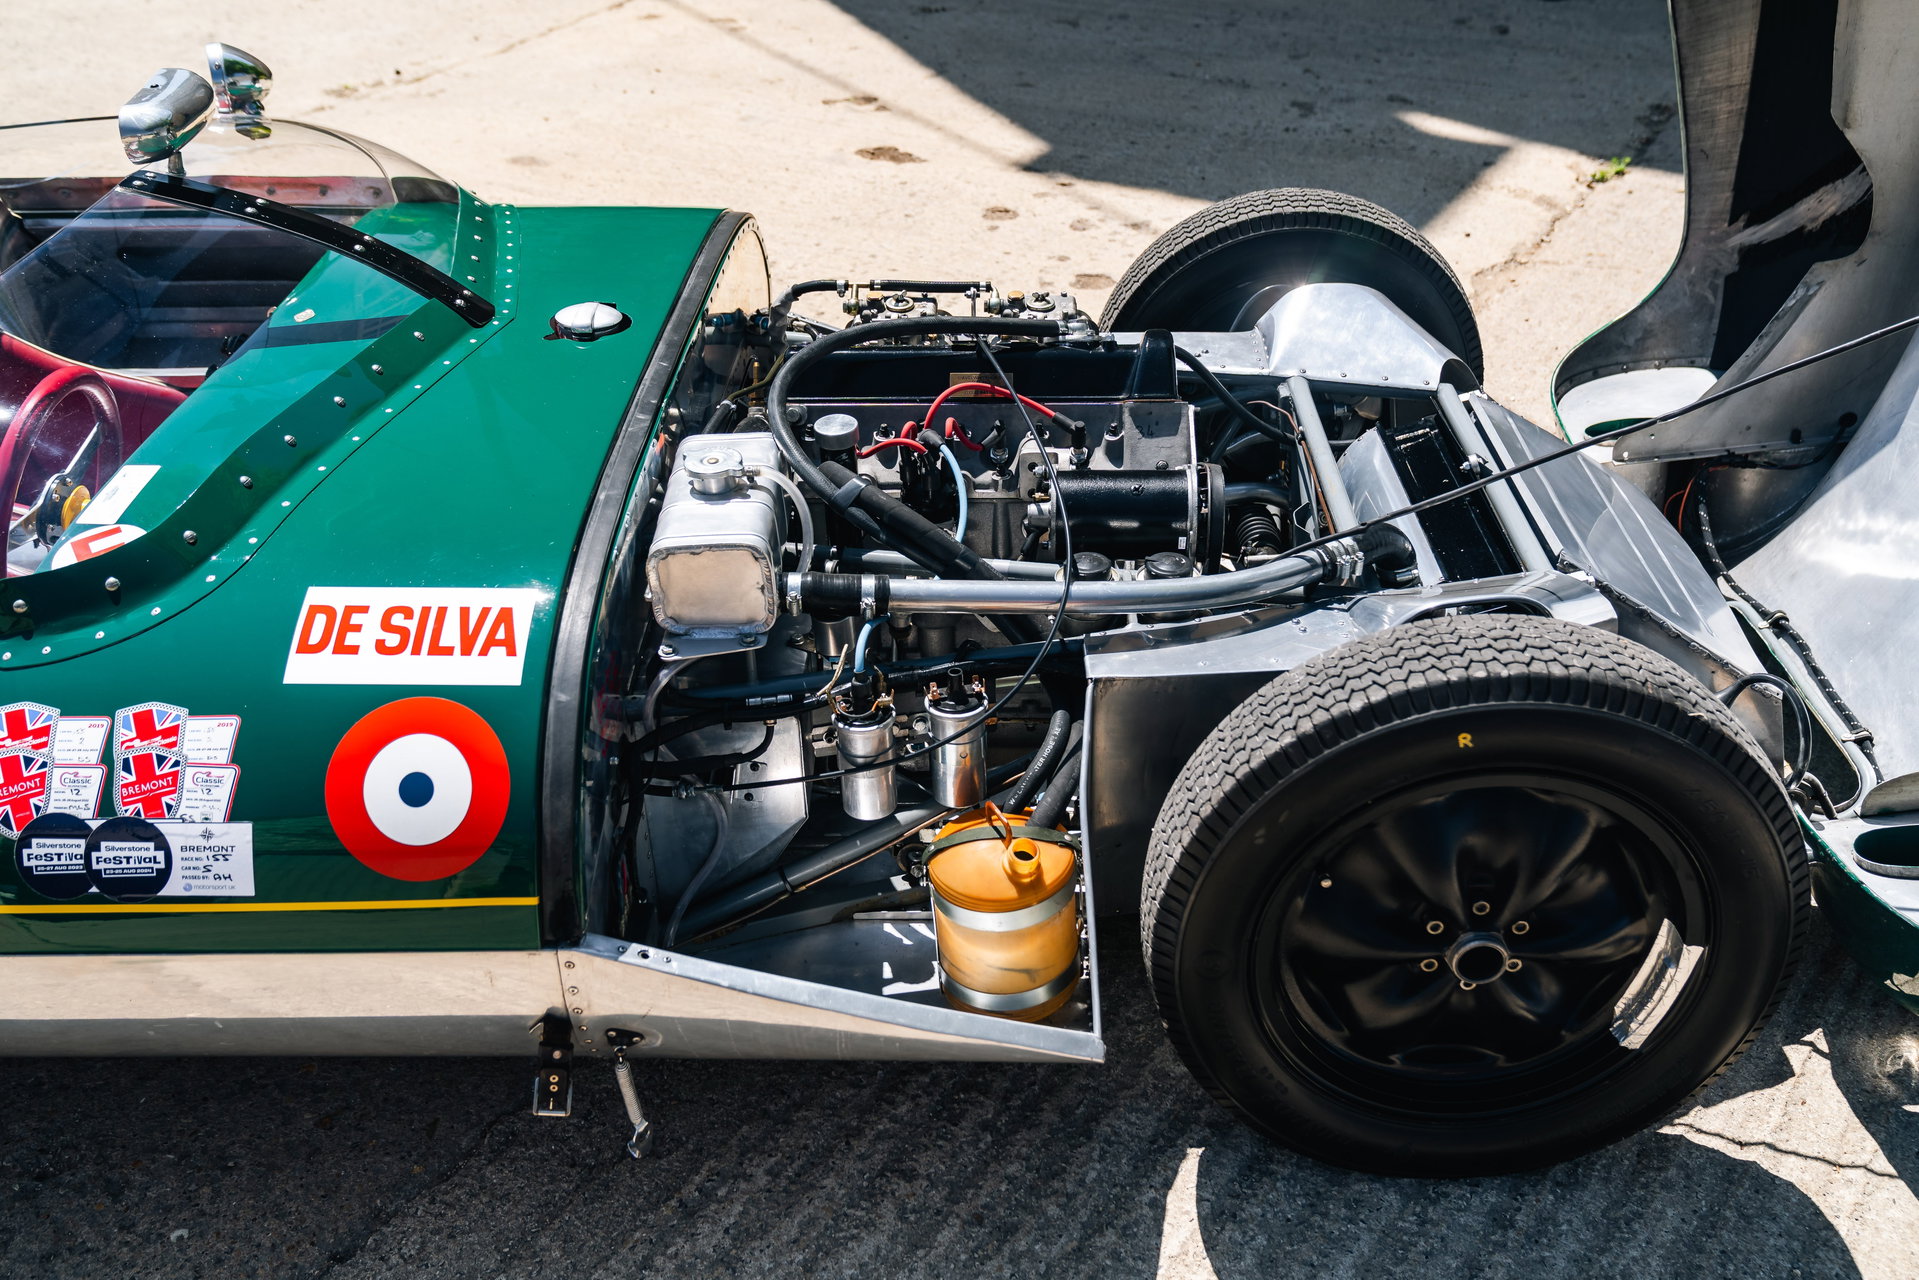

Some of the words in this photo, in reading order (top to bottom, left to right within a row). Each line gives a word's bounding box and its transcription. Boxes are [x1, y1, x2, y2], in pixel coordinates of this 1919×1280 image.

[295, 604, 371, 655] DE
[374, 605, 517, 657] SILVA
[1457, 732, 1474, 749] R
[63, 777, 92, 785] Classic
[195, 776, 225, 785] Classic
[121, 776, 173, 797] BREMONT
[70, 788, 82, 796] 12
[200, 788, 214, 796] 12
[180, 845, 236, 853] BREMONT
[27, 852, 84, 862] FeSTiVa
[206, 853, 232, 862] 155
